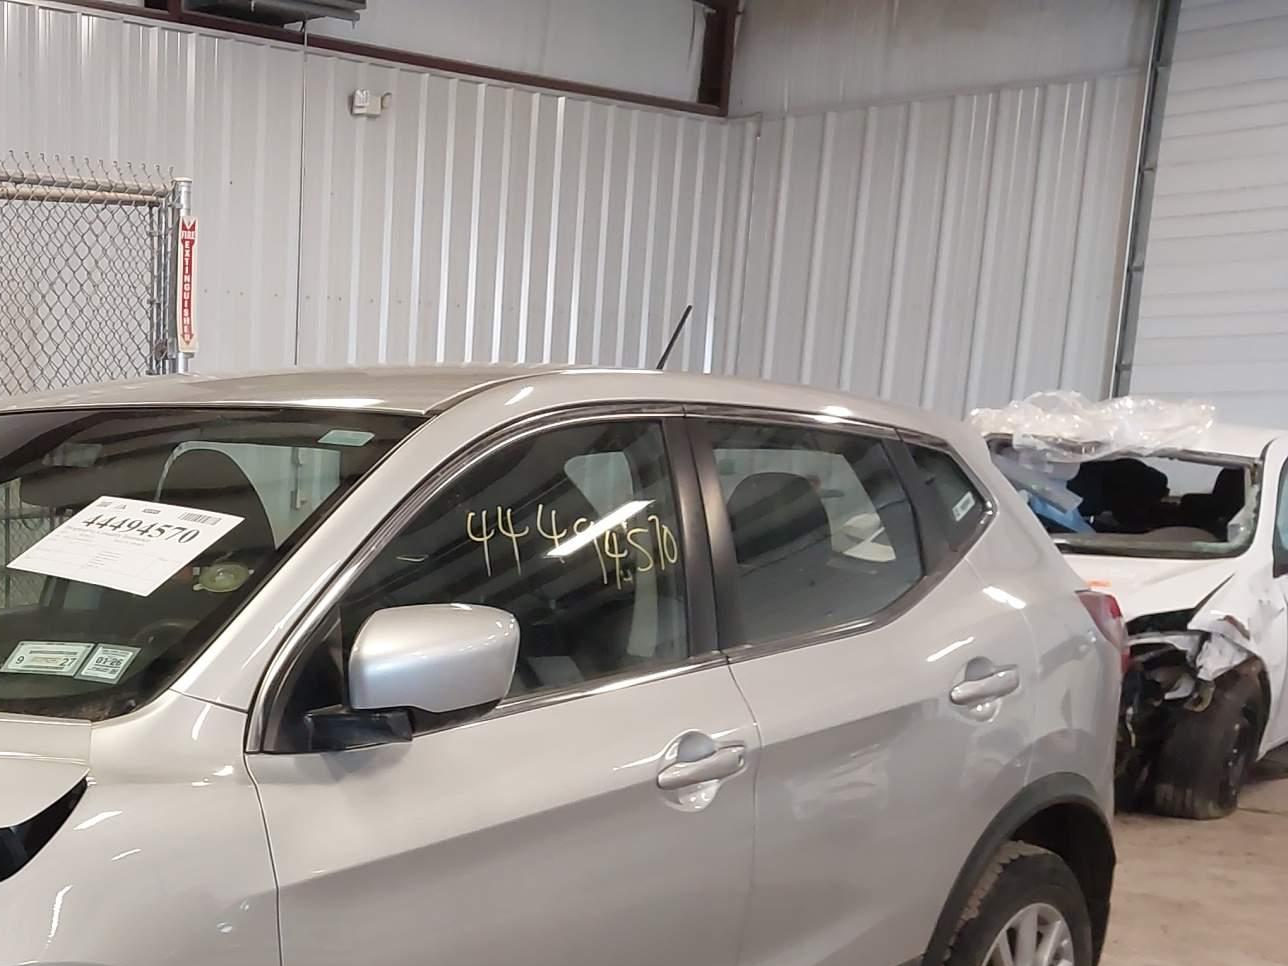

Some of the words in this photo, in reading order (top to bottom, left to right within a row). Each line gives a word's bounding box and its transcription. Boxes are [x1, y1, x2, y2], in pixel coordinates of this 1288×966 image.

[181, 230, 197, 240] FIRE
[183, 240, 192, 343] EXTINGUISHER
[81, 513, 201, 544] 44494570
[15, 655, 25, 665] 9
[59, 657, 77, 667] 27
